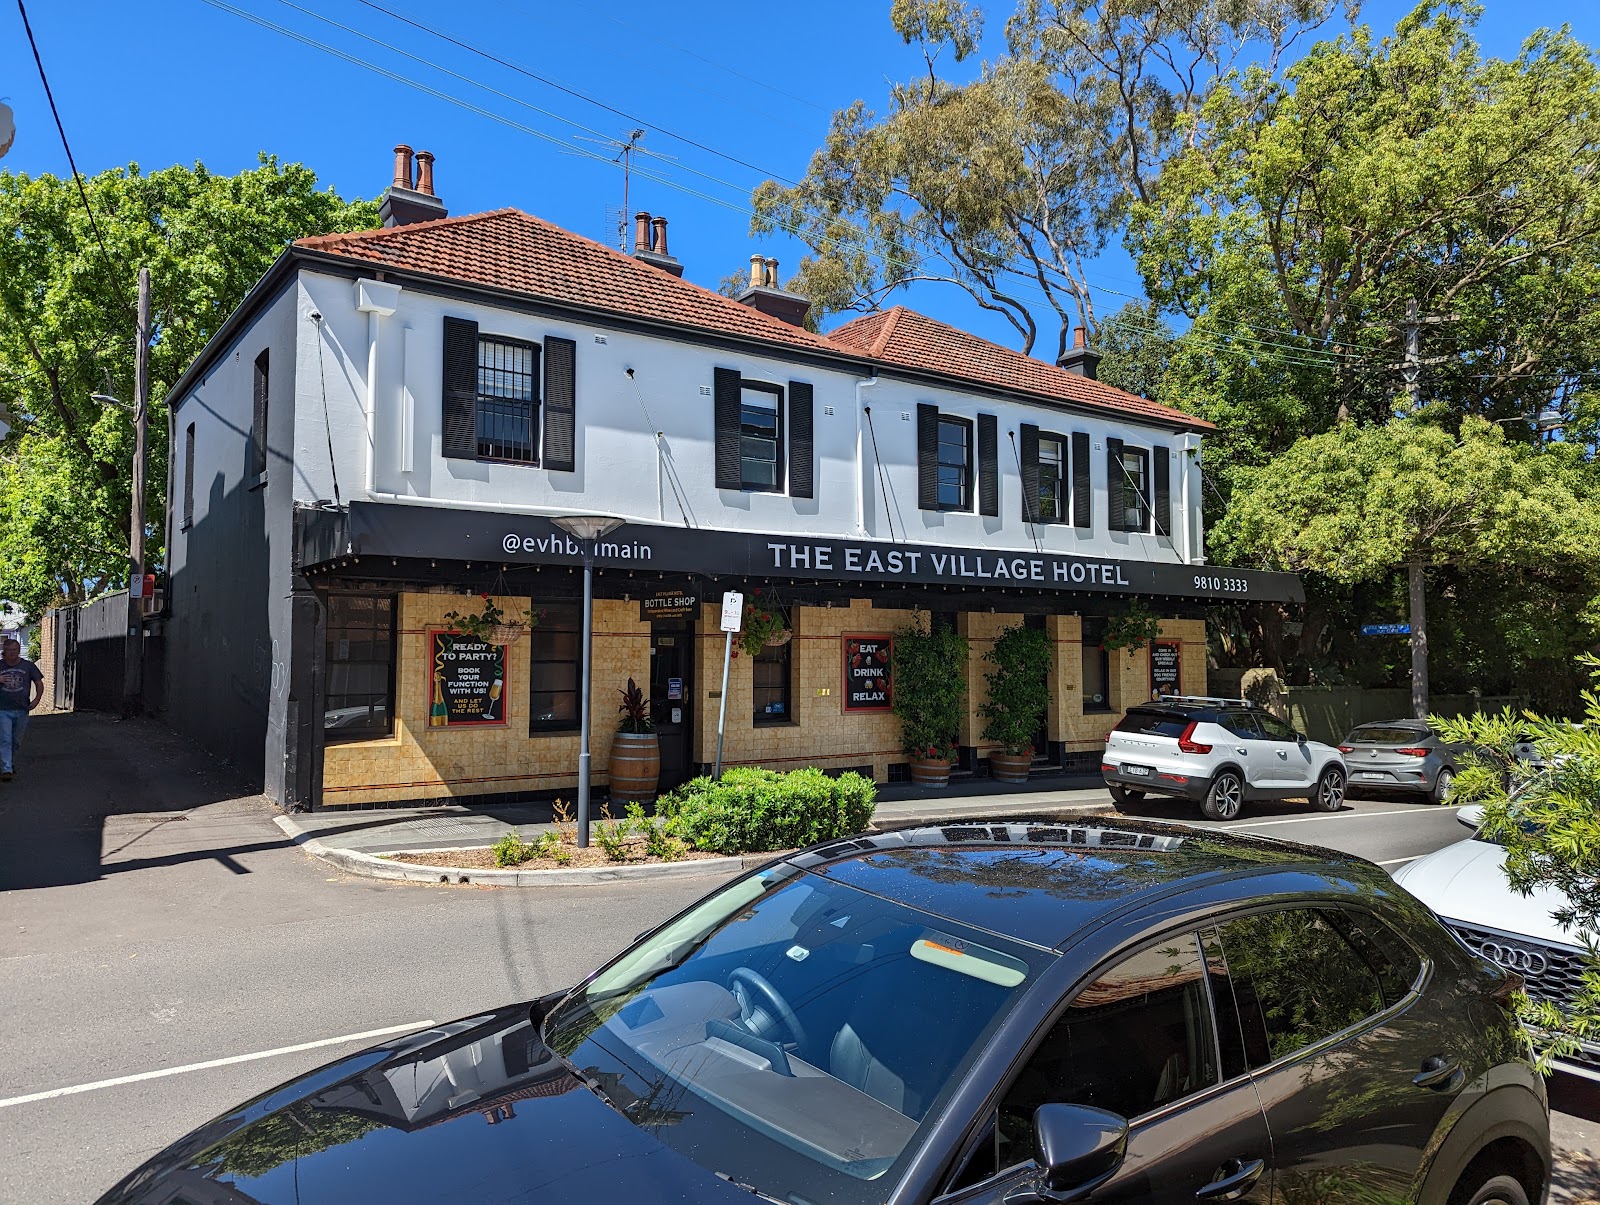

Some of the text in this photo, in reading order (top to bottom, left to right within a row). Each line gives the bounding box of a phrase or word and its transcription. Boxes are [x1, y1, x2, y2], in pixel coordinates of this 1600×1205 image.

[502, 533, 652, 560] @evhblmain
[767, 542, 1129, 586] THE EAST VILLAGE HOTEL
[1193, 575, 1249, 593] 9810 3333
[644, 596, 696, 608] BOTTLE SHOP
[452, 643, 487, 651] READY
[859, 644, 878, 654] EAT
[442, 652, 497, 661] TO PARTY?
[853, 667, 884, 677] DRINK
[852, 691, 886, 701] RELAX
